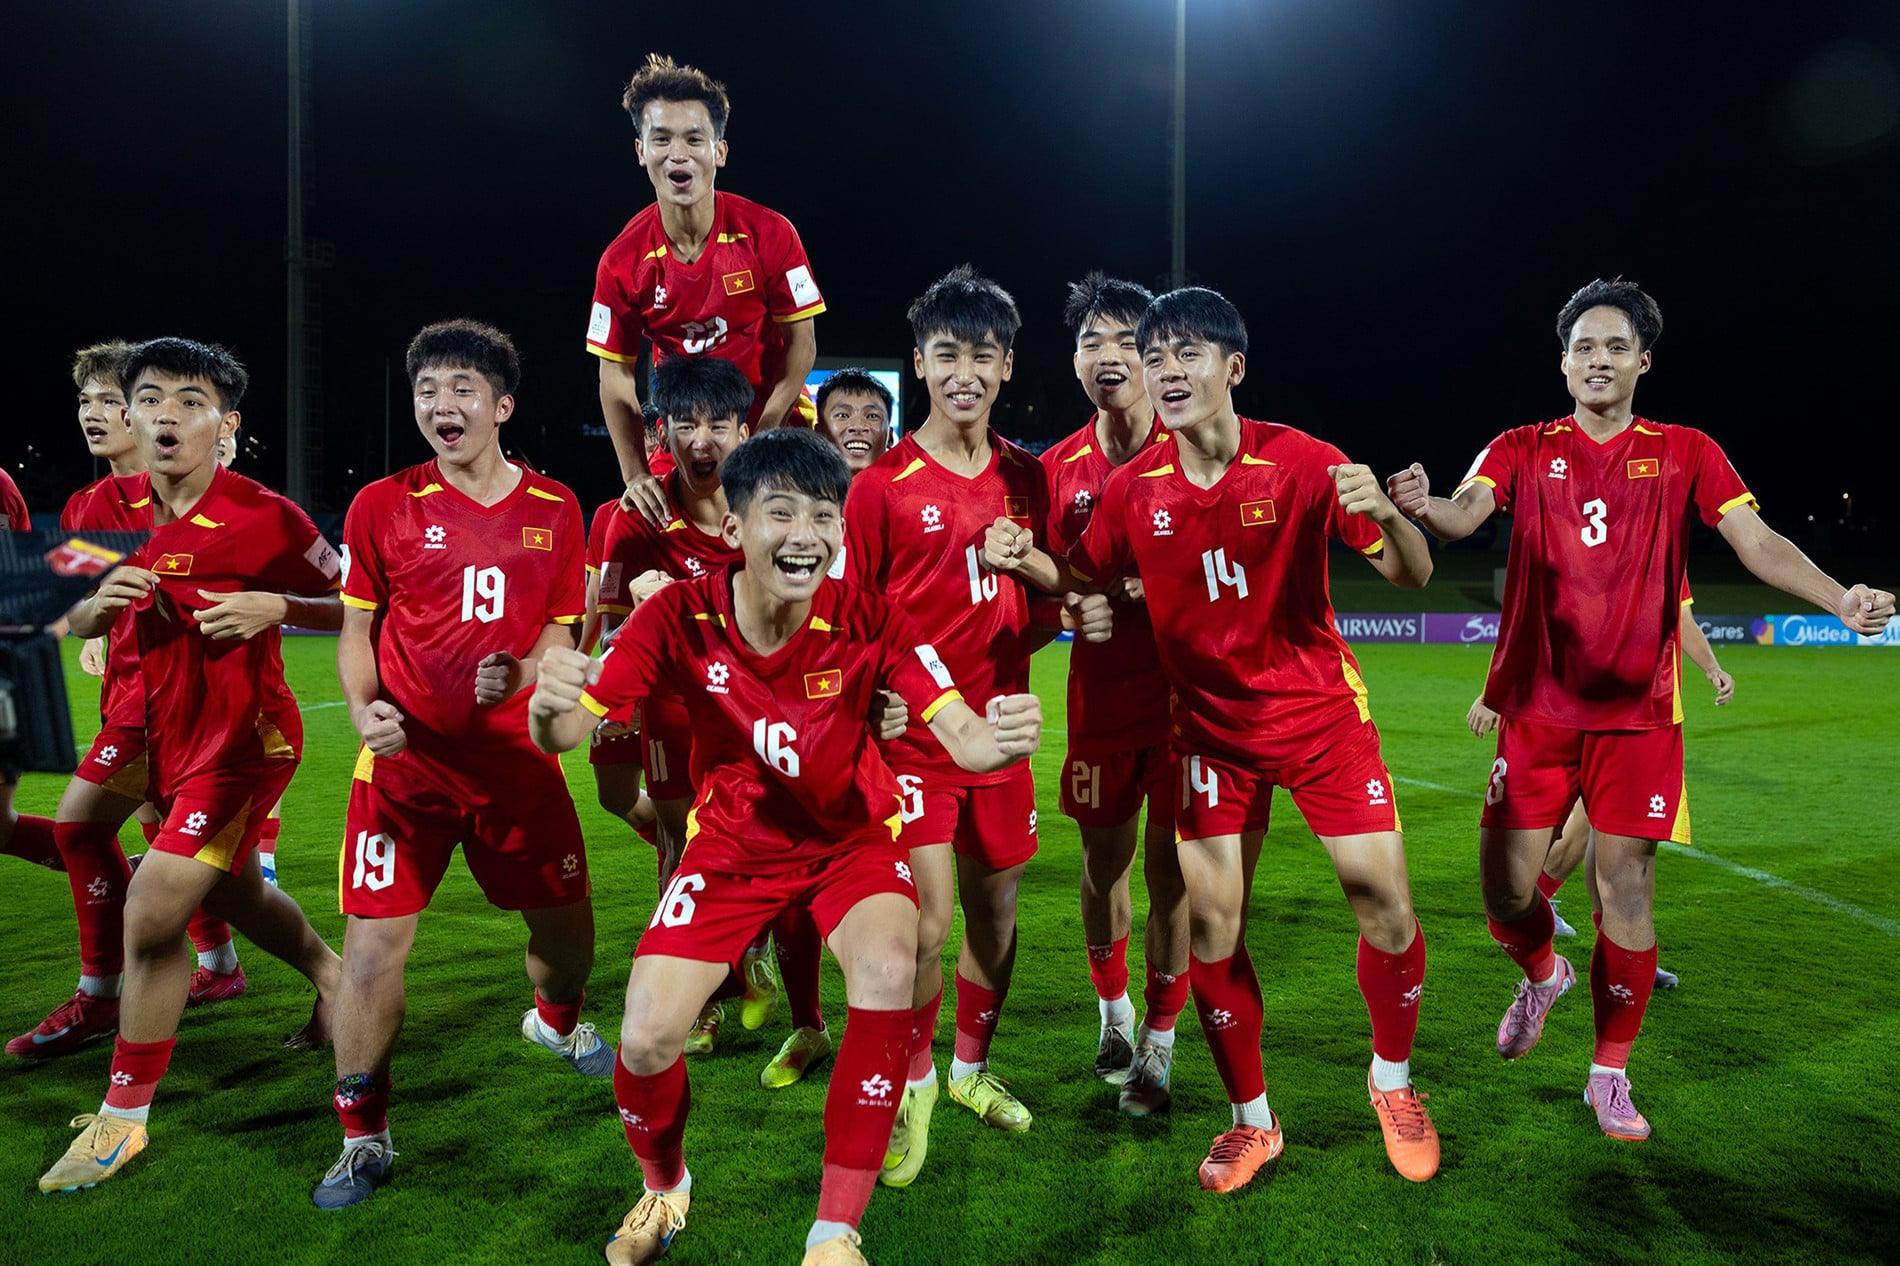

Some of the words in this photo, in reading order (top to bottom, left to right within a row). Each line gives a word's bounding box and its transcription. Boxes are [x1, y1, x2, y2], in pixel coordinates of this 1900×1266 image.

[1580, 498, 1607, 548] 3
[461, 565, 505, 623] 19
[1201, 547, 1248, 602] 14
[1701, 621, 1745, 640] Cares
[1797, 623, 1850, 642] Midea
[753, 717, 799, 777] 16
[1072, 761, 1100, 809] 21
[1182, 755, 1219, 810] 14
[1486, 756, 1508, 806] 3
[352, 830, 396, 891] 19
[649, 873, 706, 930] 16
